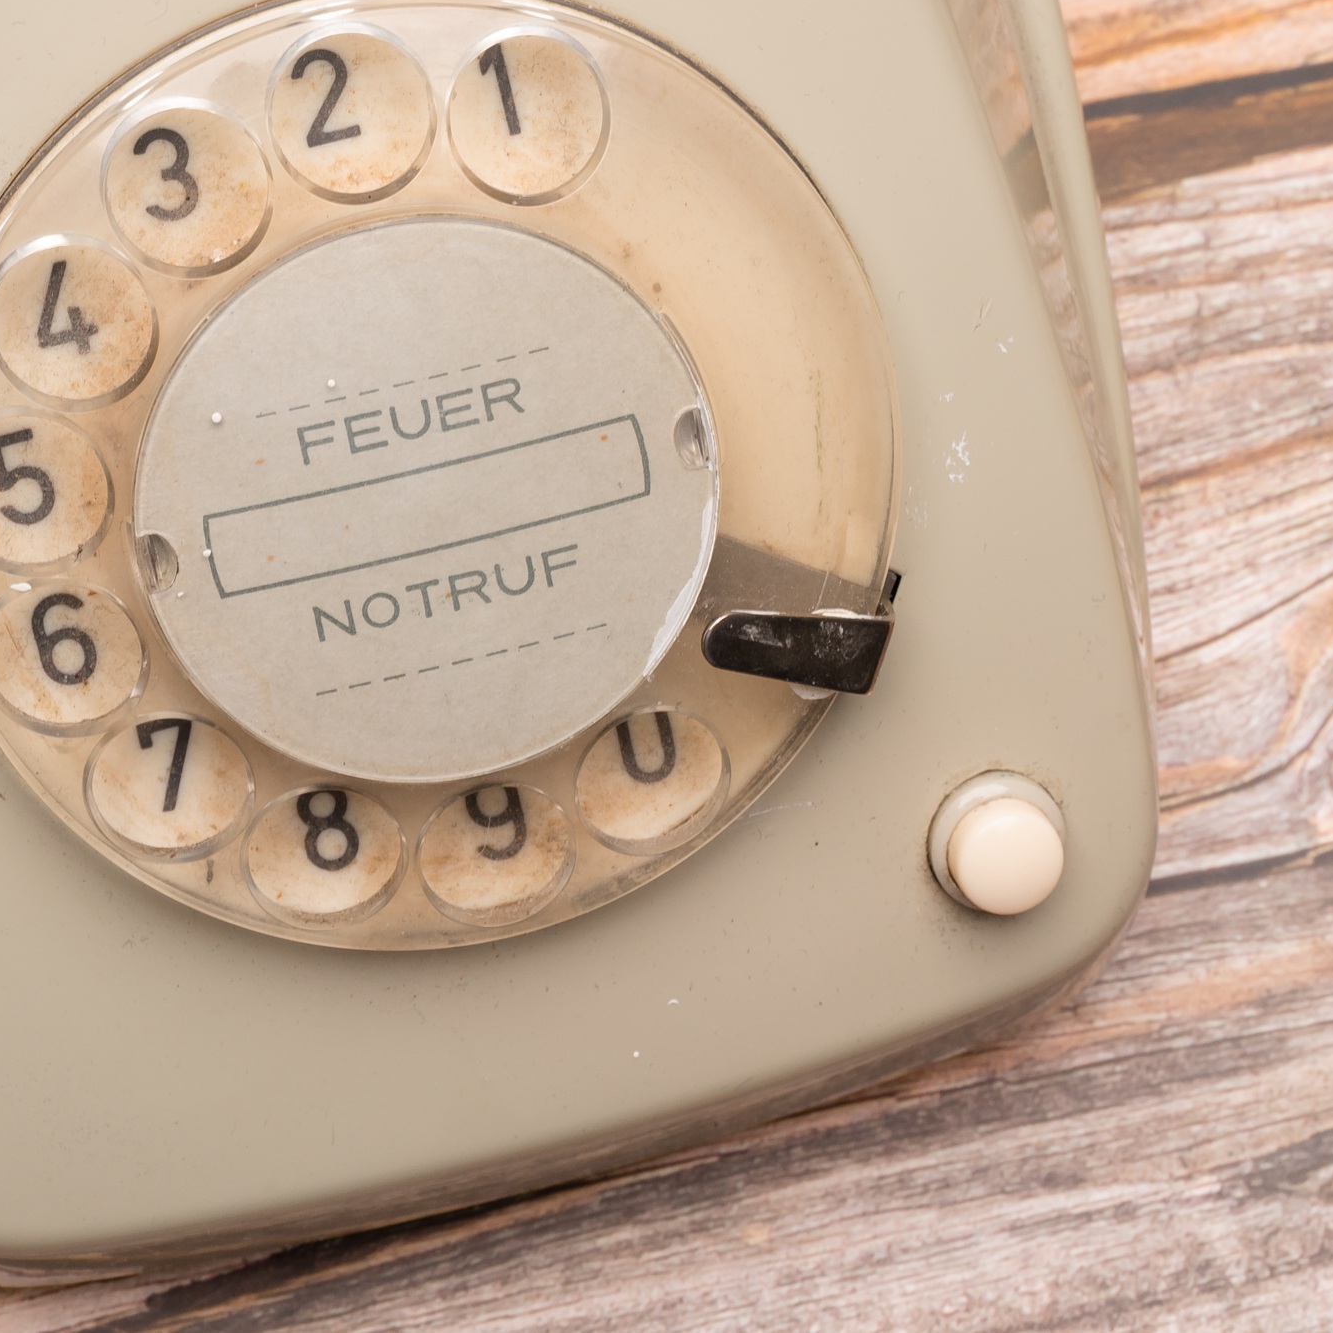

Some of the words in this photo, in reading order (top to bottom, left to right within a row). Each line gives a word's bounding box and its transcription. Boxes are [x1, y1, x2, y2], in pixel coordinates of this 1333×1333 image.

[290, 47, 361, 148] 2
[477, 43, 522, 136] 1
[132, 126, 199, 221] 3
[36, 259, 99, 354] 4
[296, 377, 526, 467] FEUER
[31, 592, 98, 686] 6
[312, 542, 581, 644] NOTRUF
[136, 716, 193, 812] 7
[296, 788, 362, 871] 8
[463, 785, 526, 862] 9
